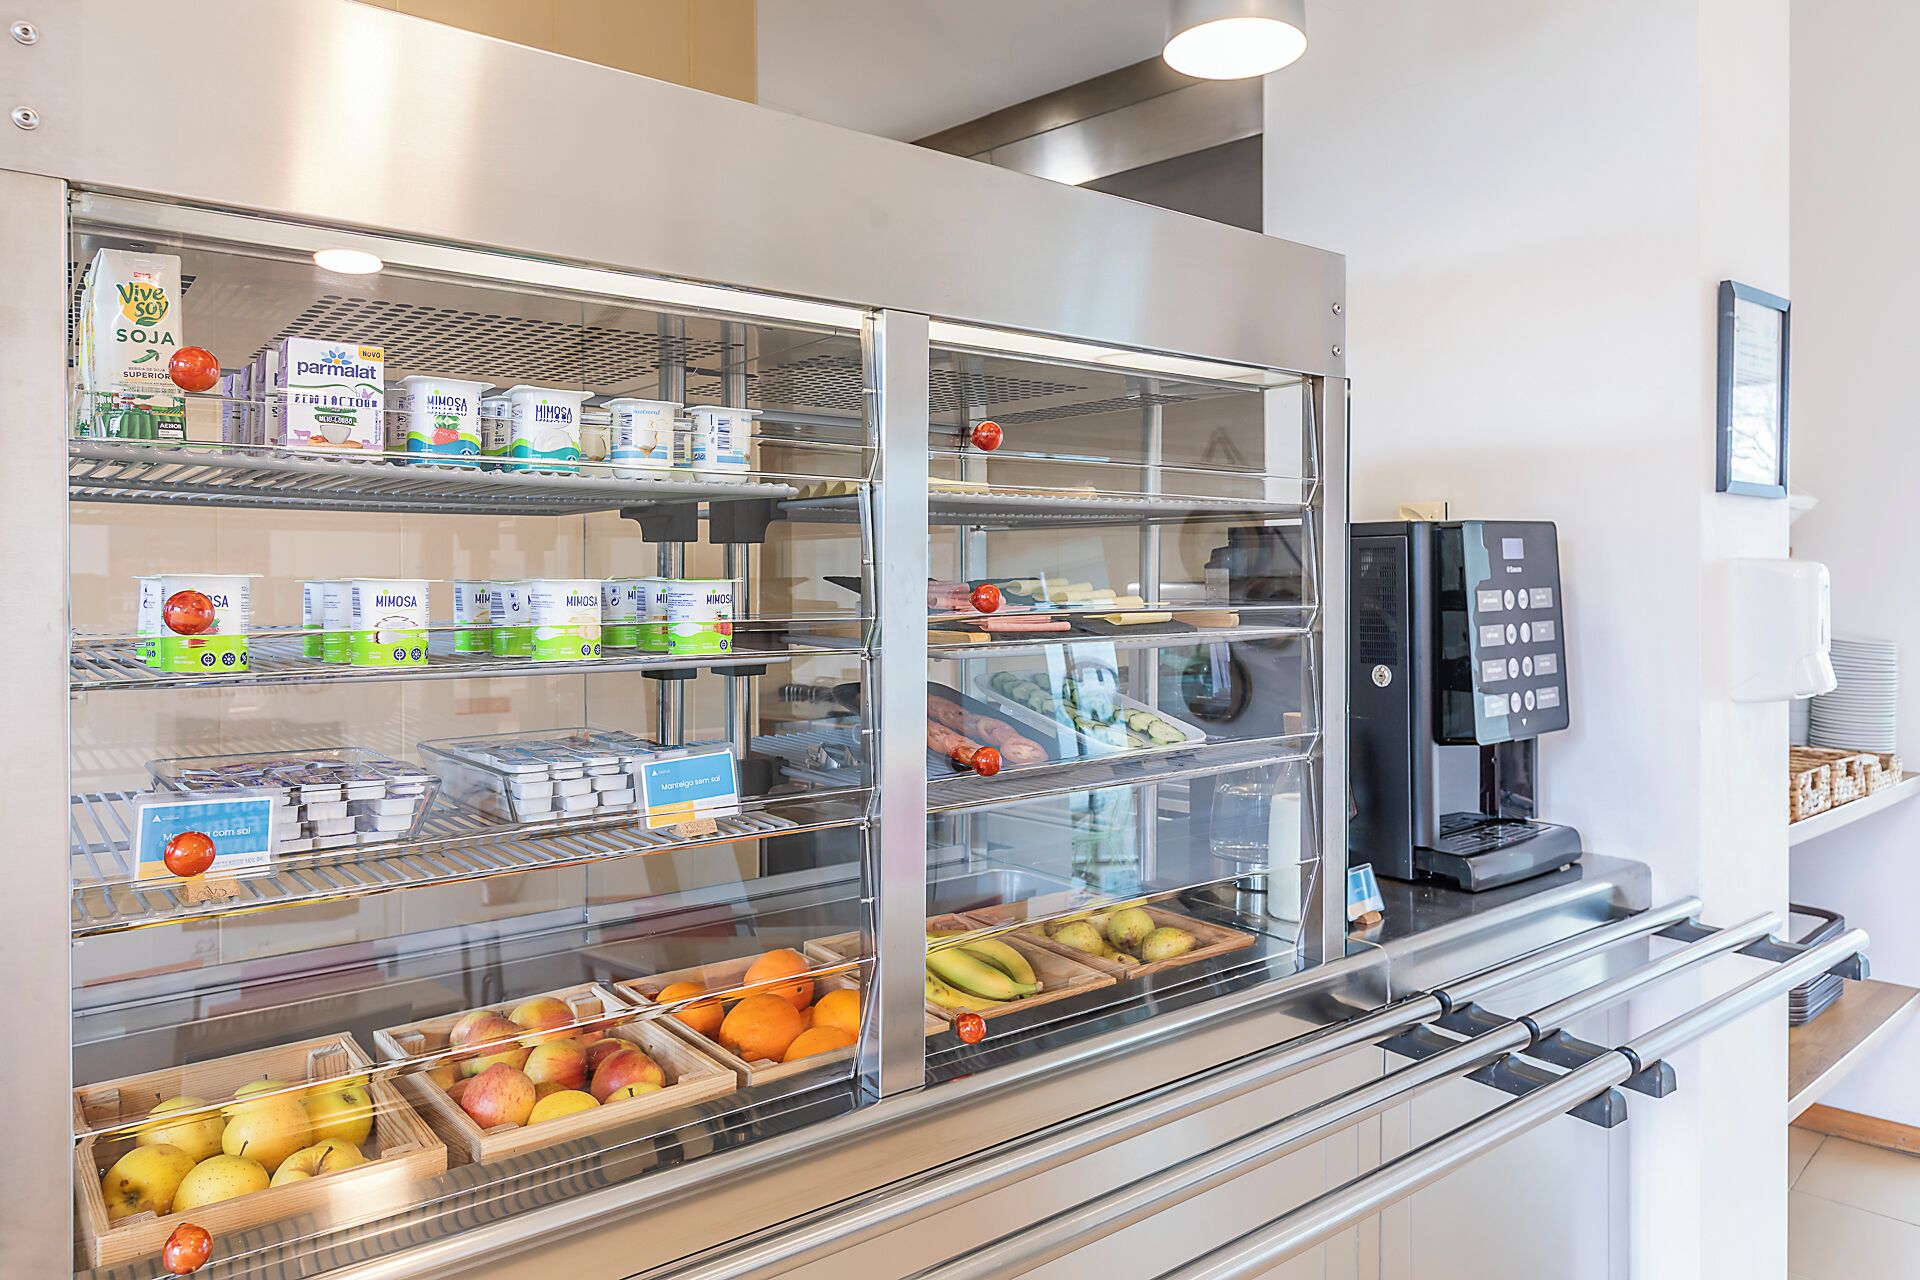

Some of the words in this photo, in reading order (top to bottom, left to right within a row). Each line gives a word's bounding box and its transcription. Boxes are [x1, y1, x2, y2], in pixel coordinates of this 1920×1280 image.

[116, 282, 164, 304] Vive
[134, 301, 169, 320] soy
[116, 328, 175, 346] SOJA
[362, 350, 381, 358] NOVO
[123, 371, 171, 380] SUPERIOR
[297, 361, 377, 379] parmalat
[375, 595, 418, 607] MIMOSA
[661, 780, 694, 791] Manteiga
[212, 828, 235, 838] com
[236, 826, 251, 836] sal
